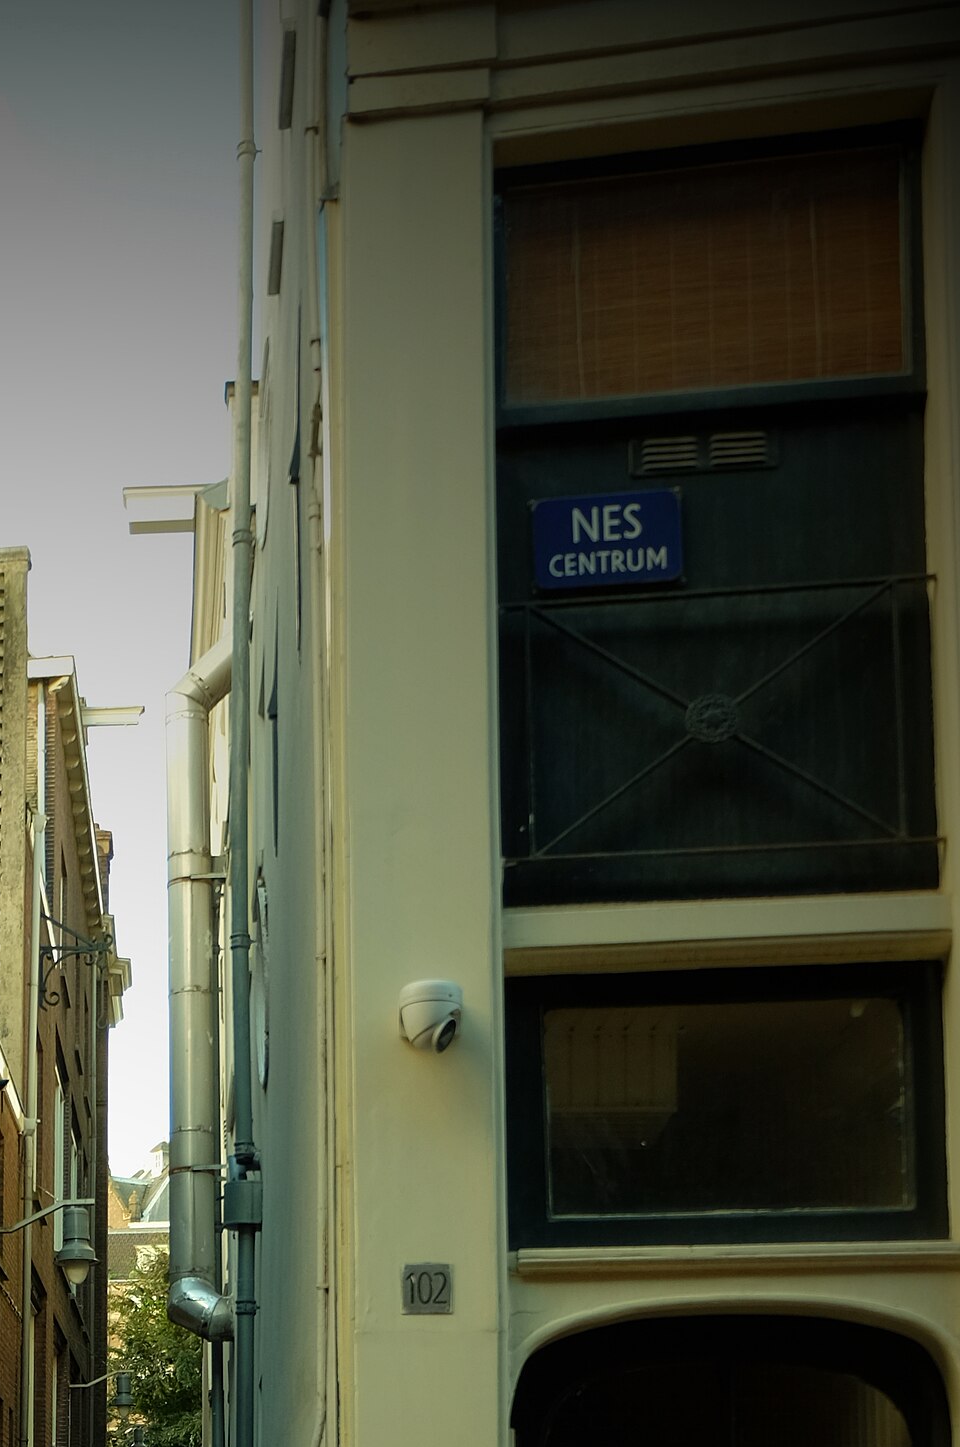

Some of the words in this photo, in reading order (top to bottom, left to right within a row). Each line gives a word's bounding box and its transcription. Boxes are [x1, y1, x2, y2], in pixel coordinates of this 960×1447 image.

[572, 503, 643, 544] NES
[549, 546, 668, 578] CENTRUM
[406, 1271, 448, 1305] 102
